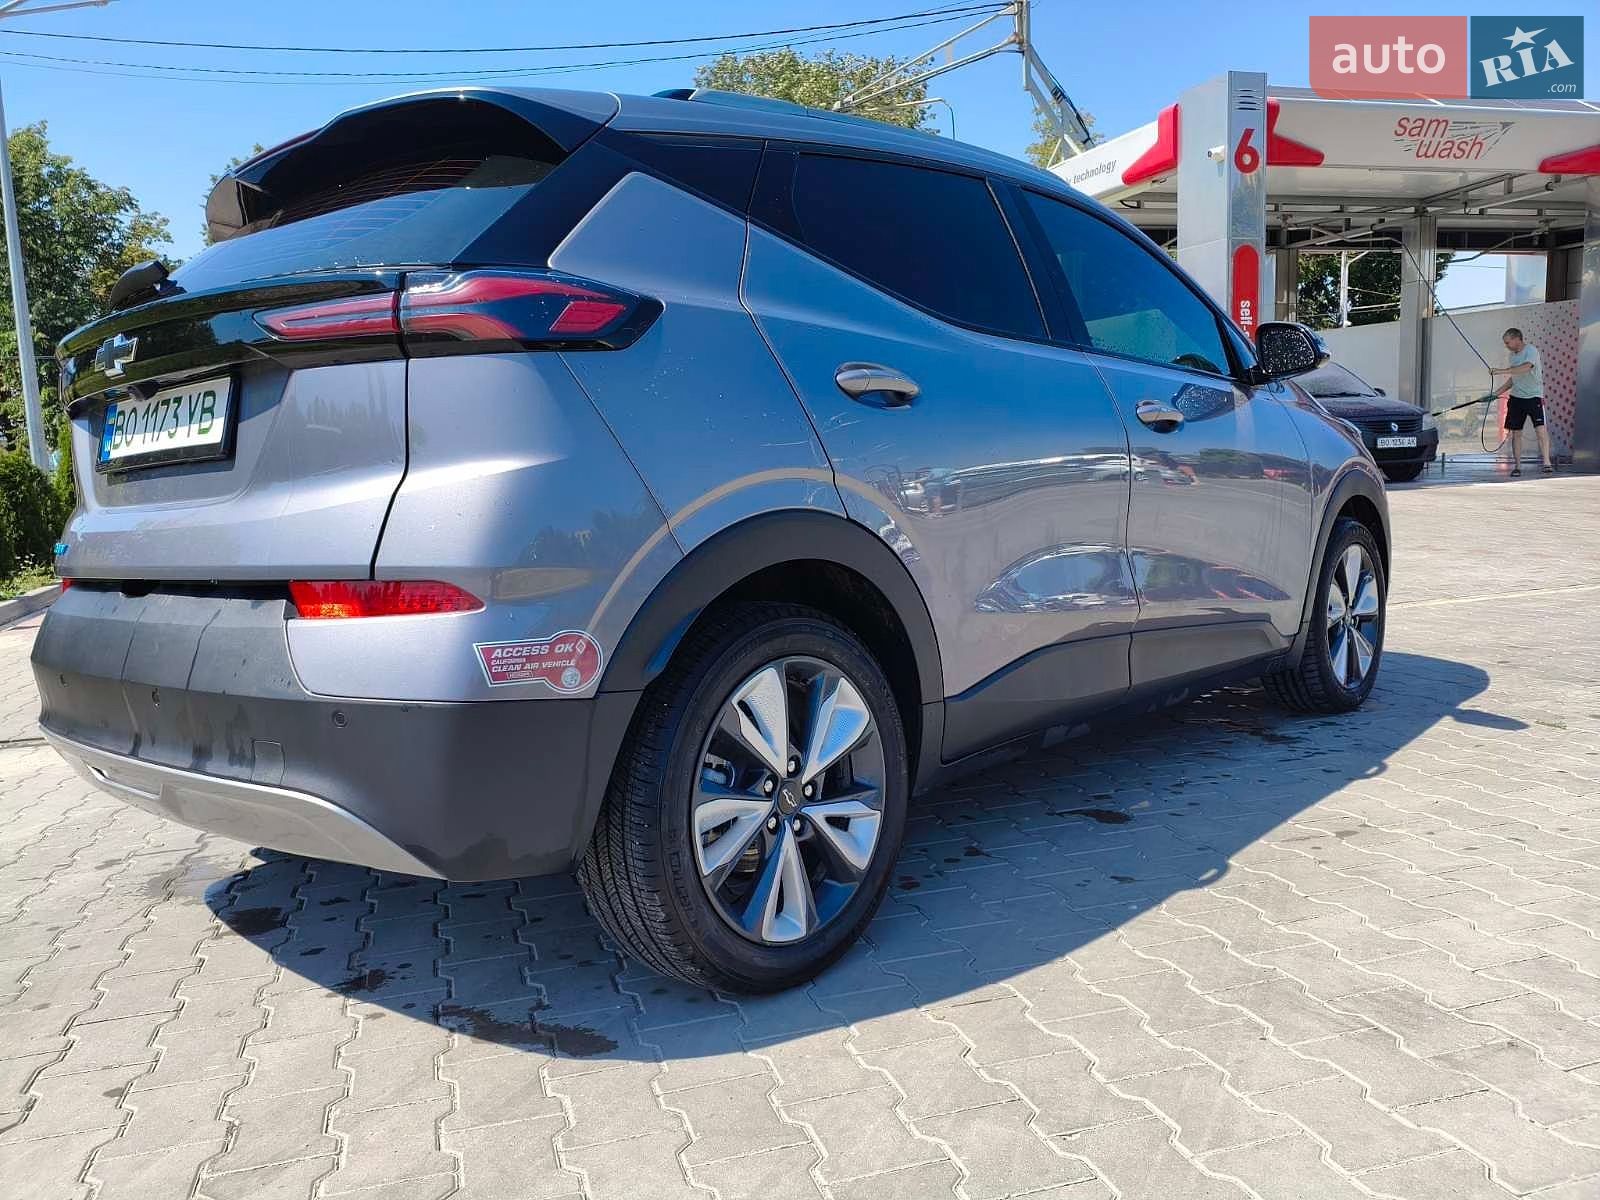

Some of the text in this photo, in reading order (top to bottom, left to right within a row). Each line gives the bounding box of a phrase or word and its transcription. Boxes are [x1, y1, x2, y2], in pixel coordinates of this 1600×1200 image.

[1394, 117, 1449, 138] sam
[1234, 127, 1260, 174] 6
[1415, 133, 1485, 160] wash
[1073, 159, 1117, 184] technology
[112, 390, 216, 450] BO 1173 YB
[491, 642, 575, 659] ACCESS OK
[492, 659, 576, 673] CLEAN AIR VEHICLE
